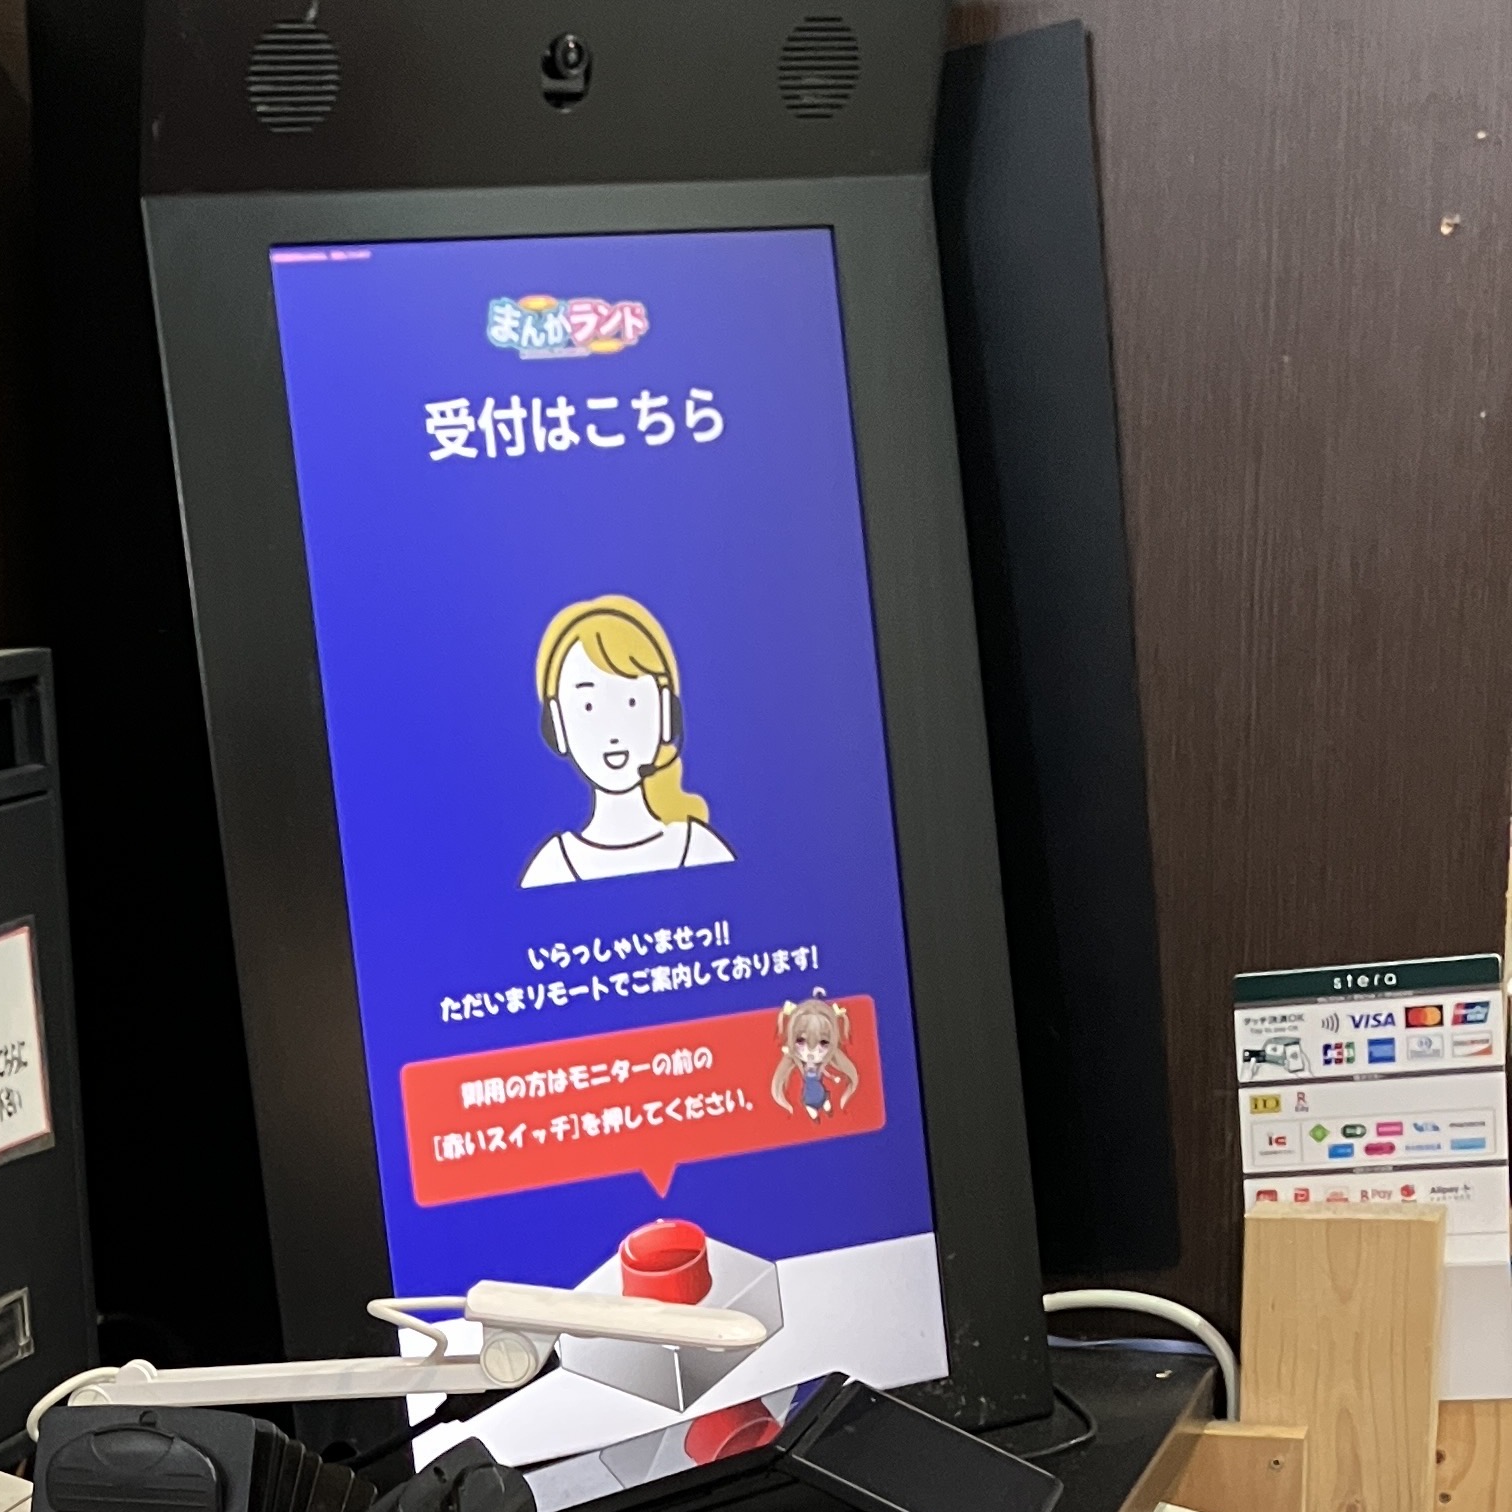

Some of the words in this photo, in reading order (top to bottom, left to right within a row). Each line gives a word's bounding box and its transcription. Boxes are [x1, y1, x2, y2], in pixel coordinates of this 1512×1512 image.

[425, 389, 725, 461] 受付はこちら
[1333, 972, 1397, 990] stera
[1347, 1012, 1396, 1029] VISA
[460, 1045, 713, 1110] 御用の方はモニターの前の
